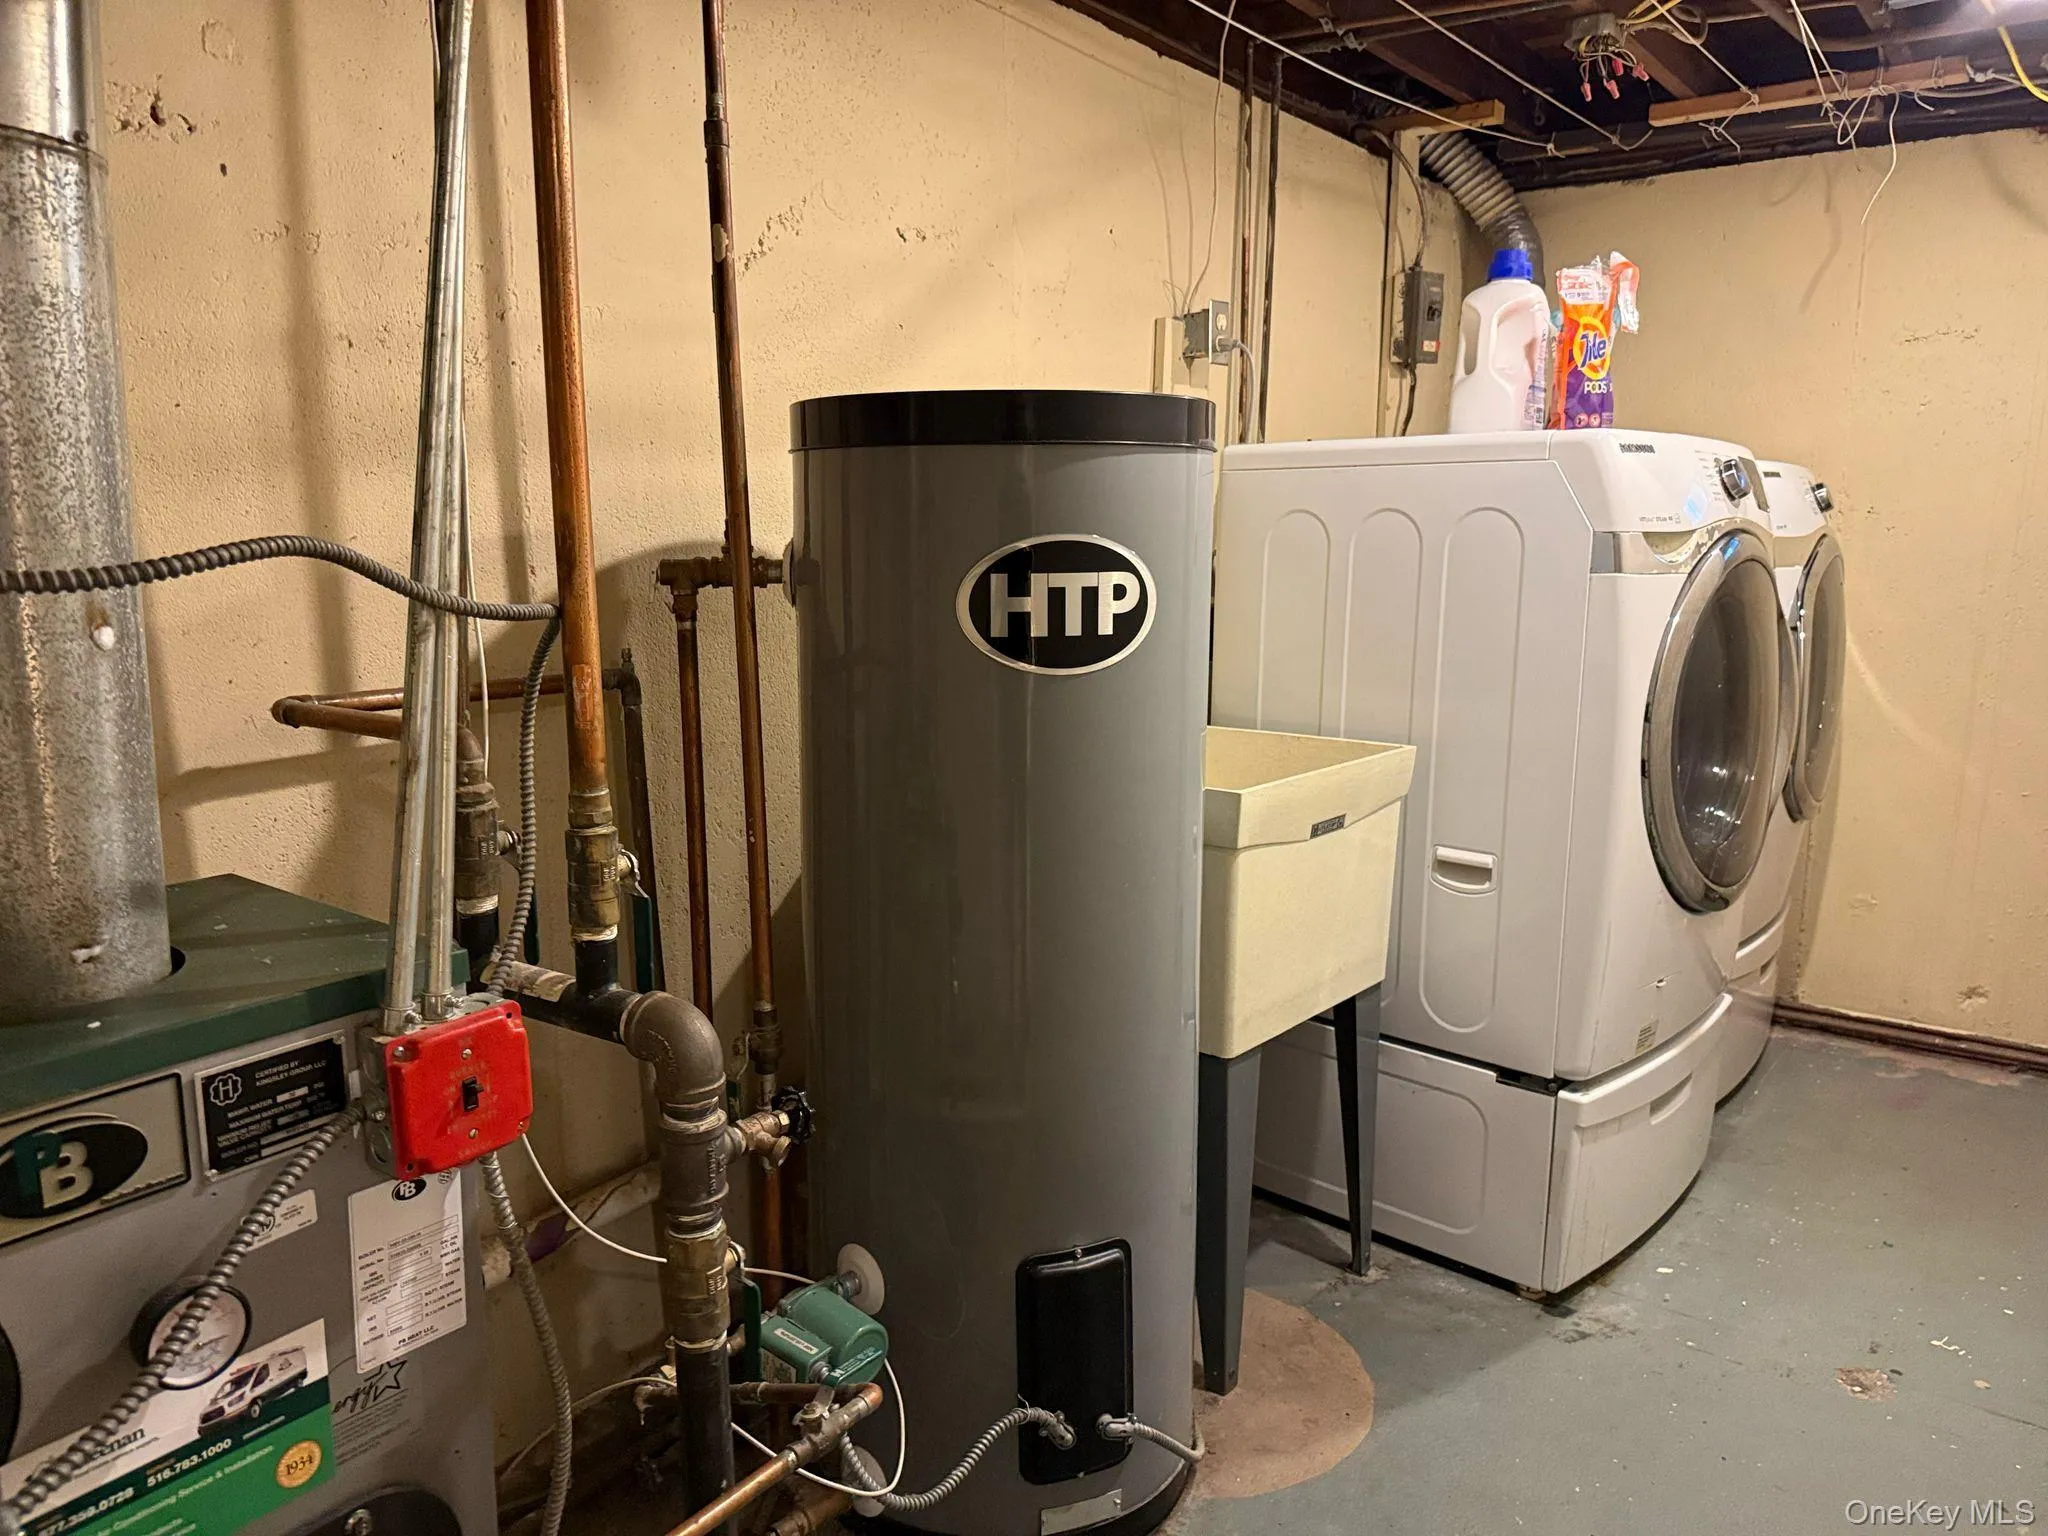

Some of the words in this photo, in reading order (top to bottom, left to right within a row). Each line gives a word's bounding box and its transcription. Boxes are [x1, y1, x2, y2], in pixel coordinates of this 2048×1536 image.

[1580, 332, 1607, 368] Tide
[1584, 381, 1608, 394] PODS
[990, 571, 1141, 637] HTP
[12, 1131, 94, 1209] PB
[400, 1181, 417, 1198] PB
[147, 1438, 232, 1487] 516.783.1000
